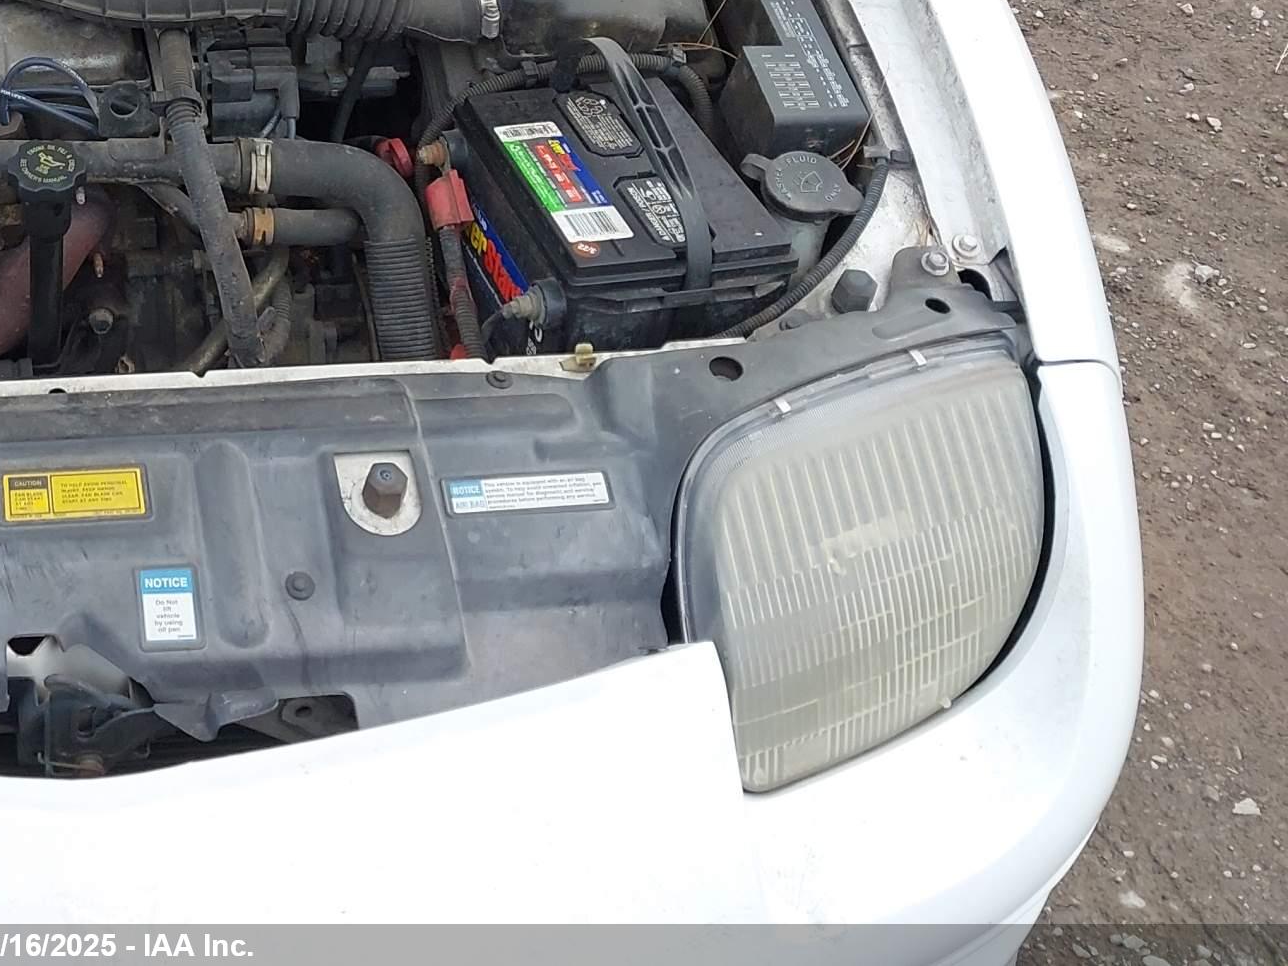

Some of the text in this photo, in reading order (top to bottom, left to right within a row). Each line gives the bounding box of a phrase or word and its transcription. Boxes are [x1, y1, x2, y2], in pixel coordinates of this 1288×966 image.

[785, 155, 817, 166] FLUID
[825, 184, 841, 202] ONLY
[453, 485, 481, 495] NOTICE
[144, 577, 189, 588] NOTICE
